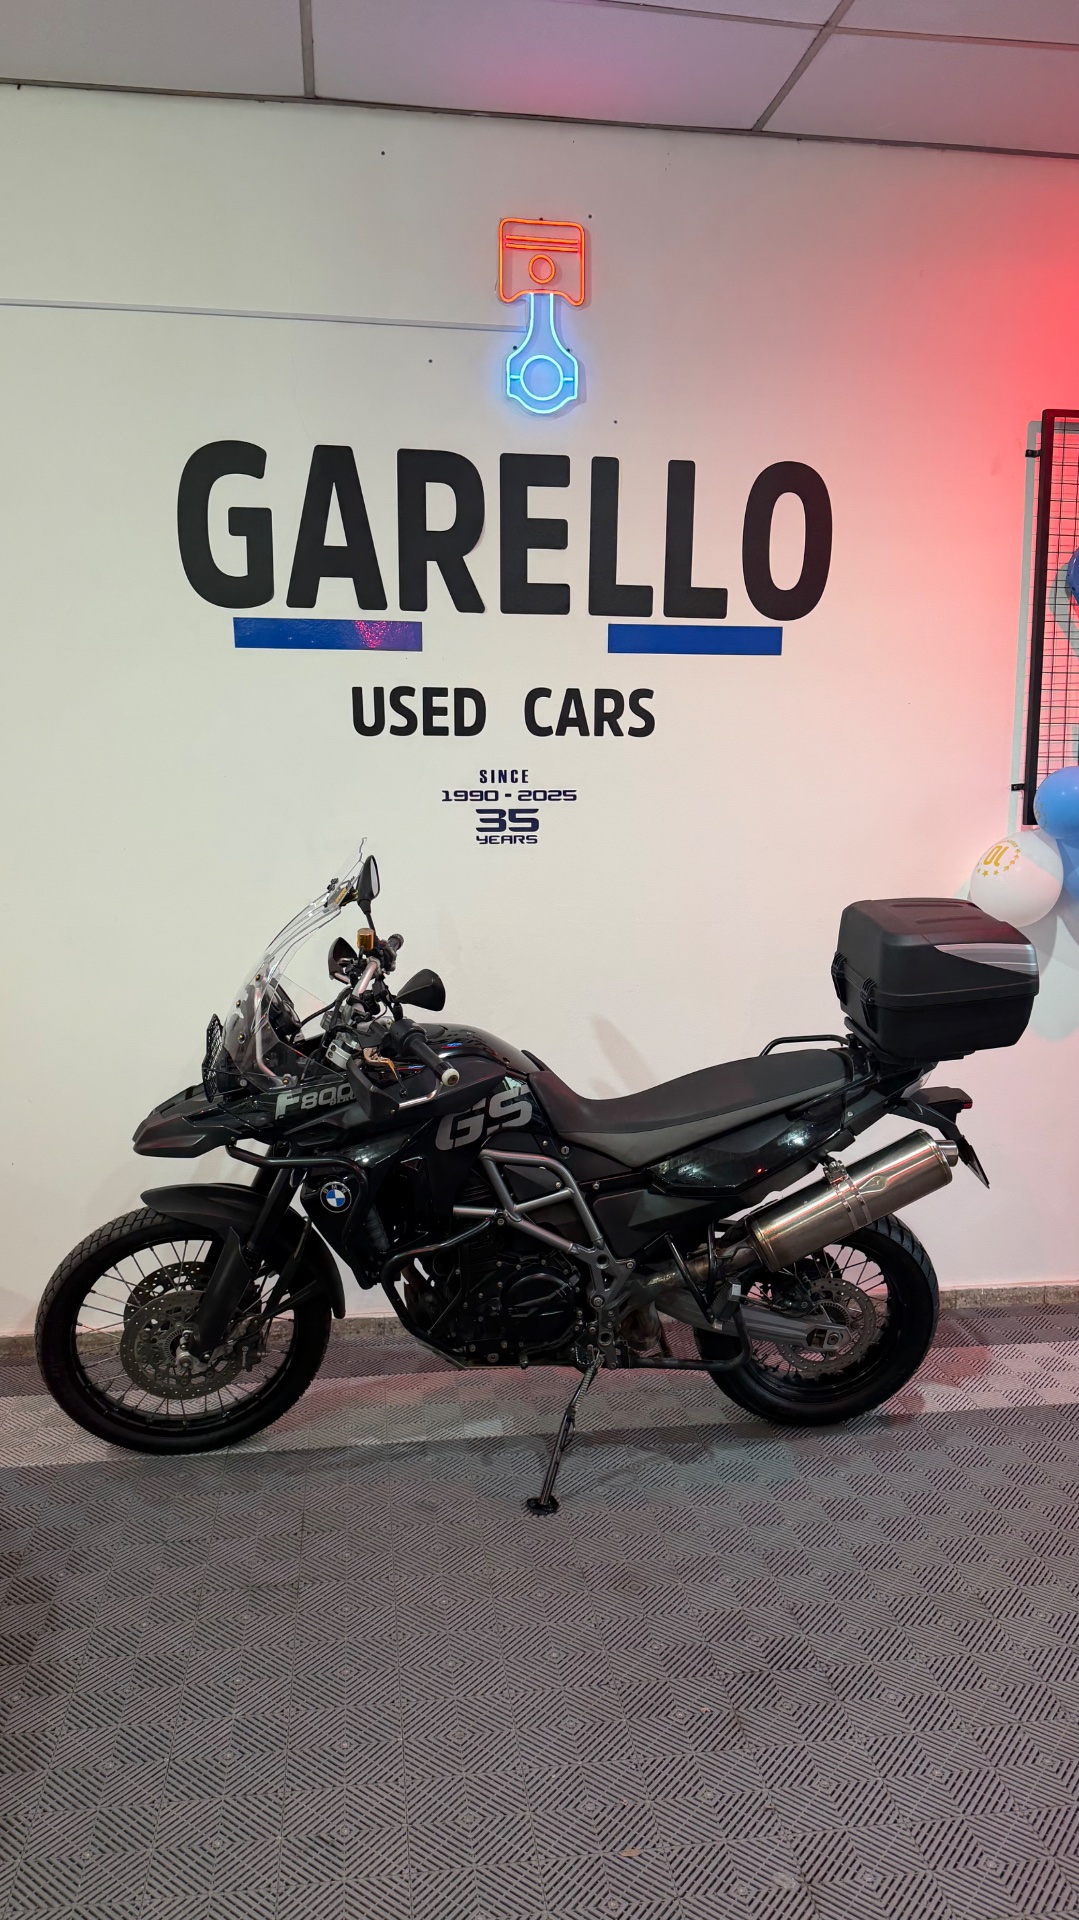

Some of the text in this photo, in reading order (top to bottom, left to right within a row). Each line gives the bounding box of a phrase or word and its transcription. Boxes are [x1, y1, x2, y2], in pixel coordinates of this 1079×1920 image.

[176, 440, 833, 622] GARELLO
[351, 685, 656, 738] USED CARS
[479, 769, 529, 784] SINCE
[475, 808, 540, 833] 35
[475, 834, 538, 845] YEARS
[435, 1083, 532, 1151] GS
